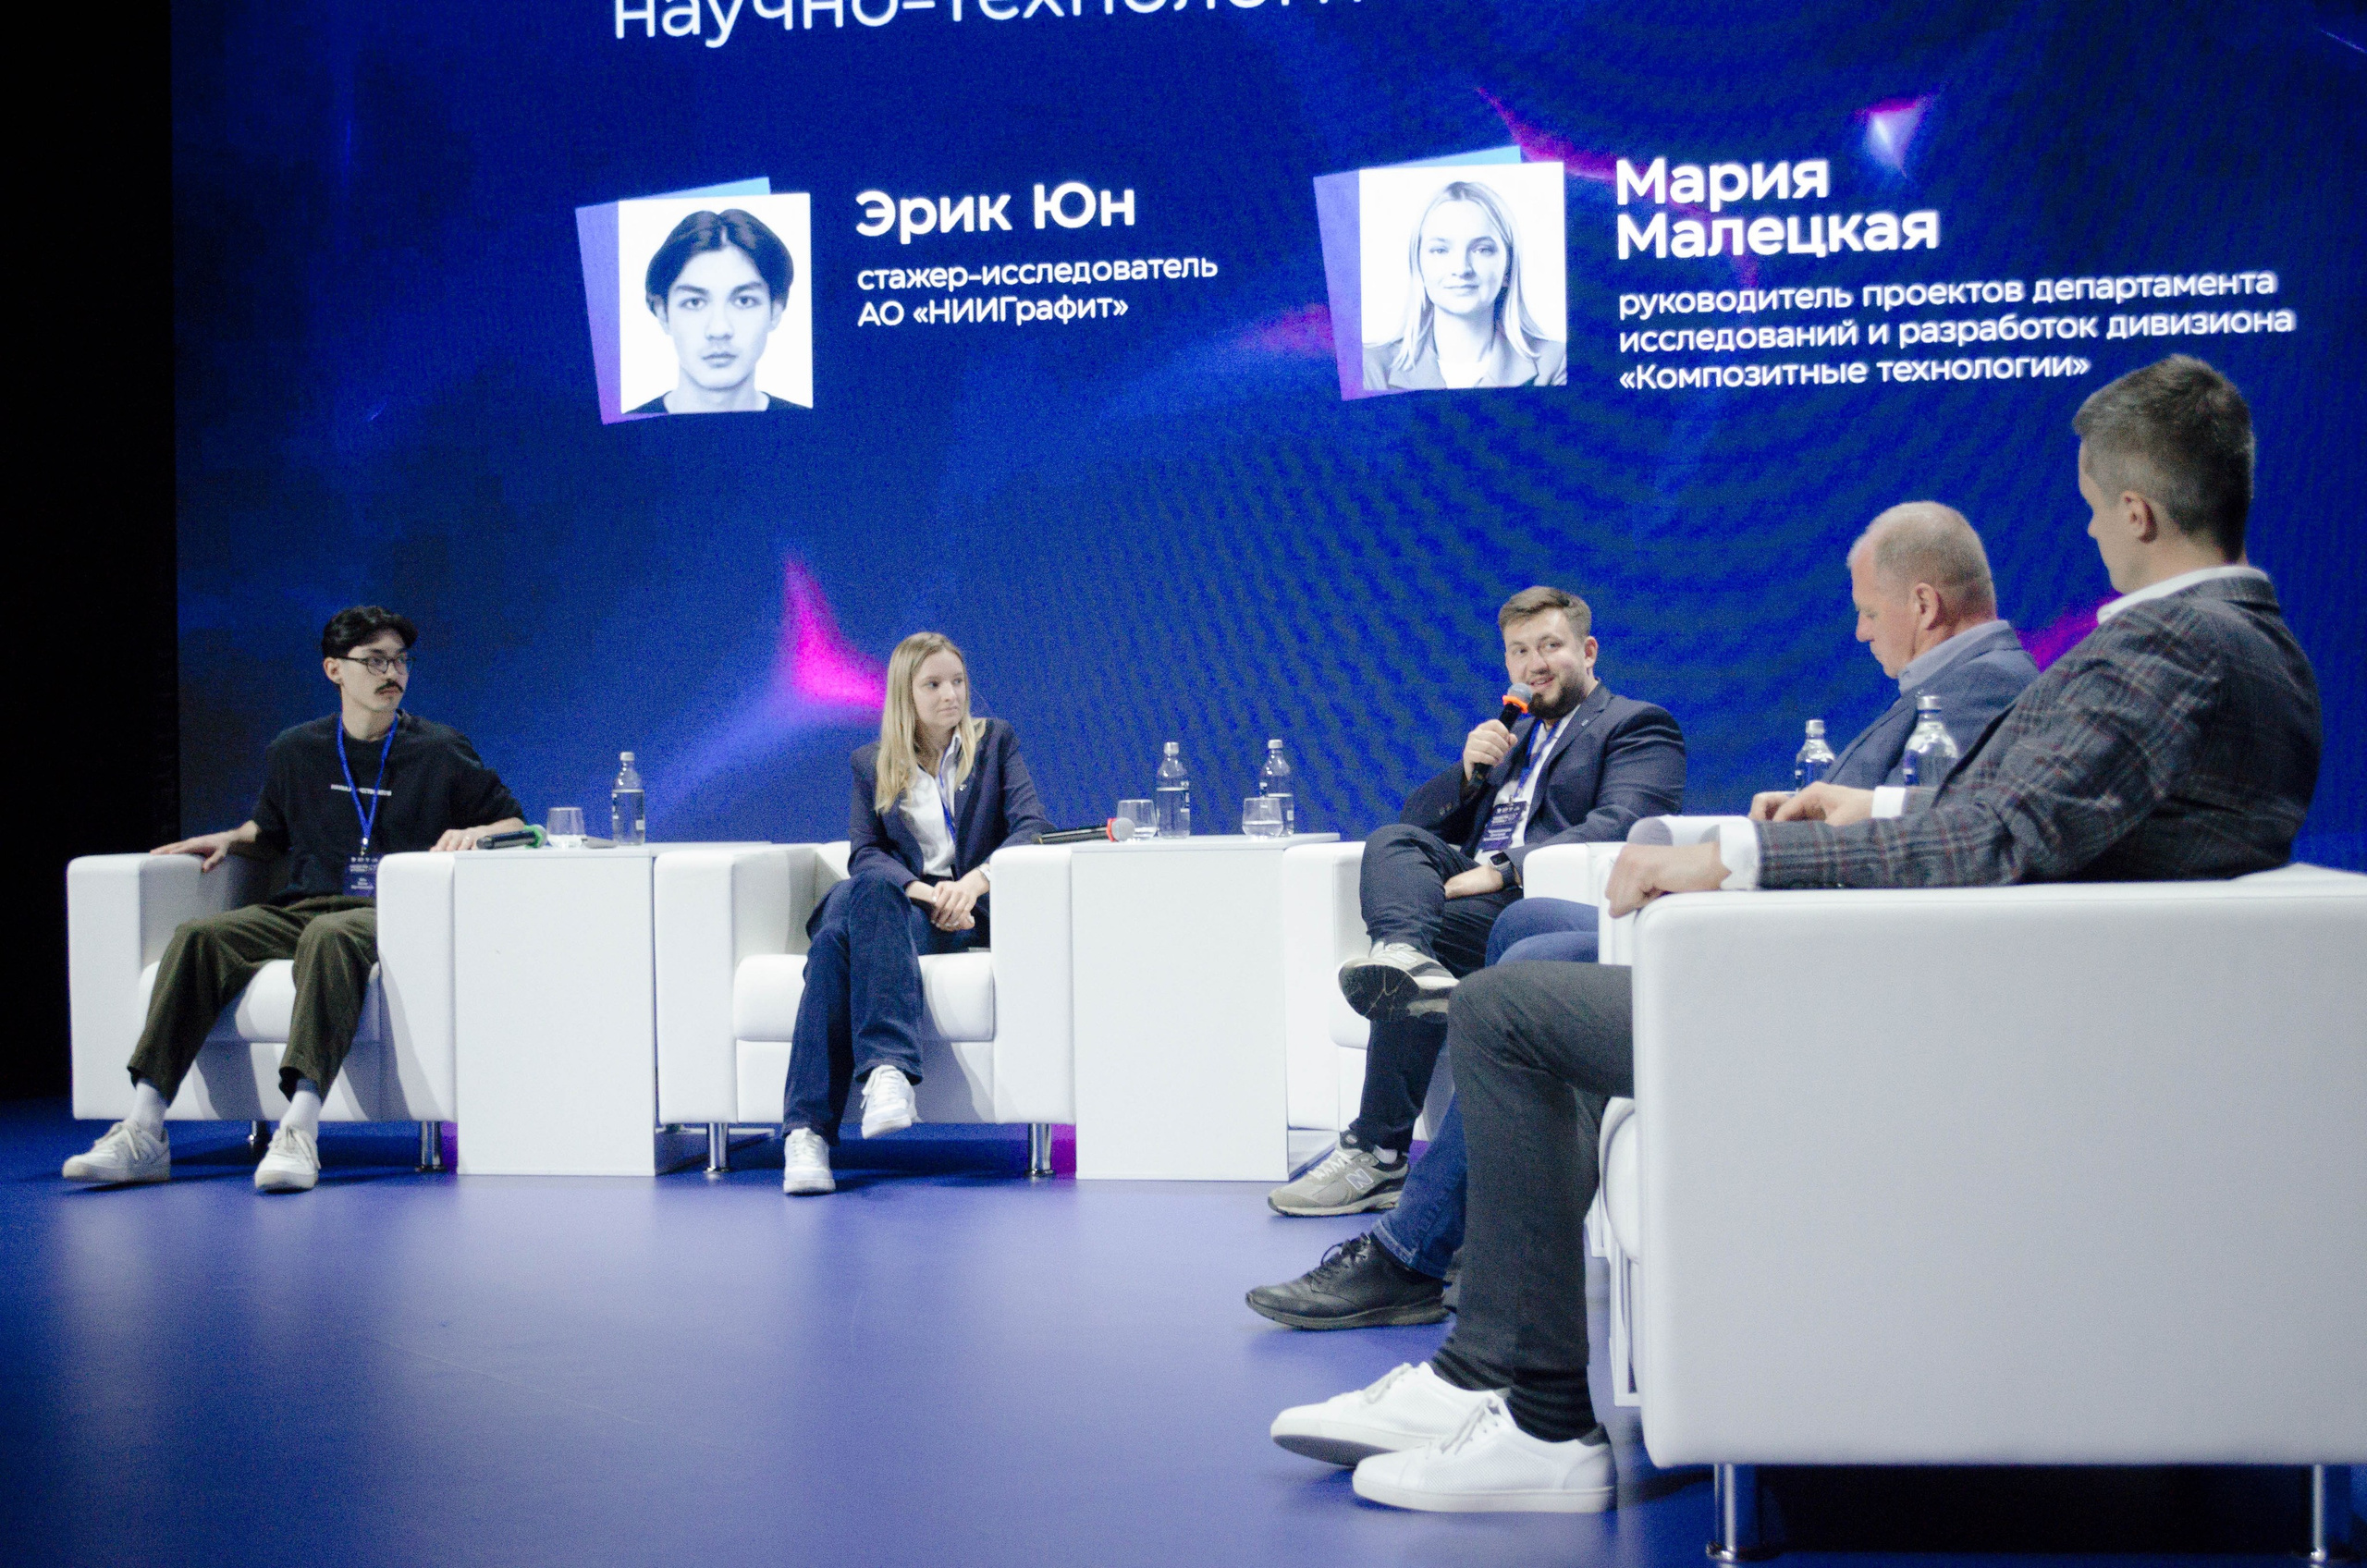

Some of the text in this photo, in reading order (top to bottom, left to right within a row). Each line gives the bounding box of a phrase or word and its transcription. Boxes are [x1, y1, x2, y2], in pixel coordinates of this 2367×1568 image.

[1614, 155, 1830, 214] Мария
[855, 181, 1136, 245] Эрик Юн
[1616, 210, 1941, 260] Малецкая
[856, 257, 1220, 293] стажер-исследователь
[1618, 271, 2278, 321] руководитель проектов департамента
[856, 294, 1130, 327] АО «НИИГрафит»
[1618, 309, 2297, 353] исследований и разработок дивизиона
[1618, 355, 2091, 391] «Композитные технологии»
